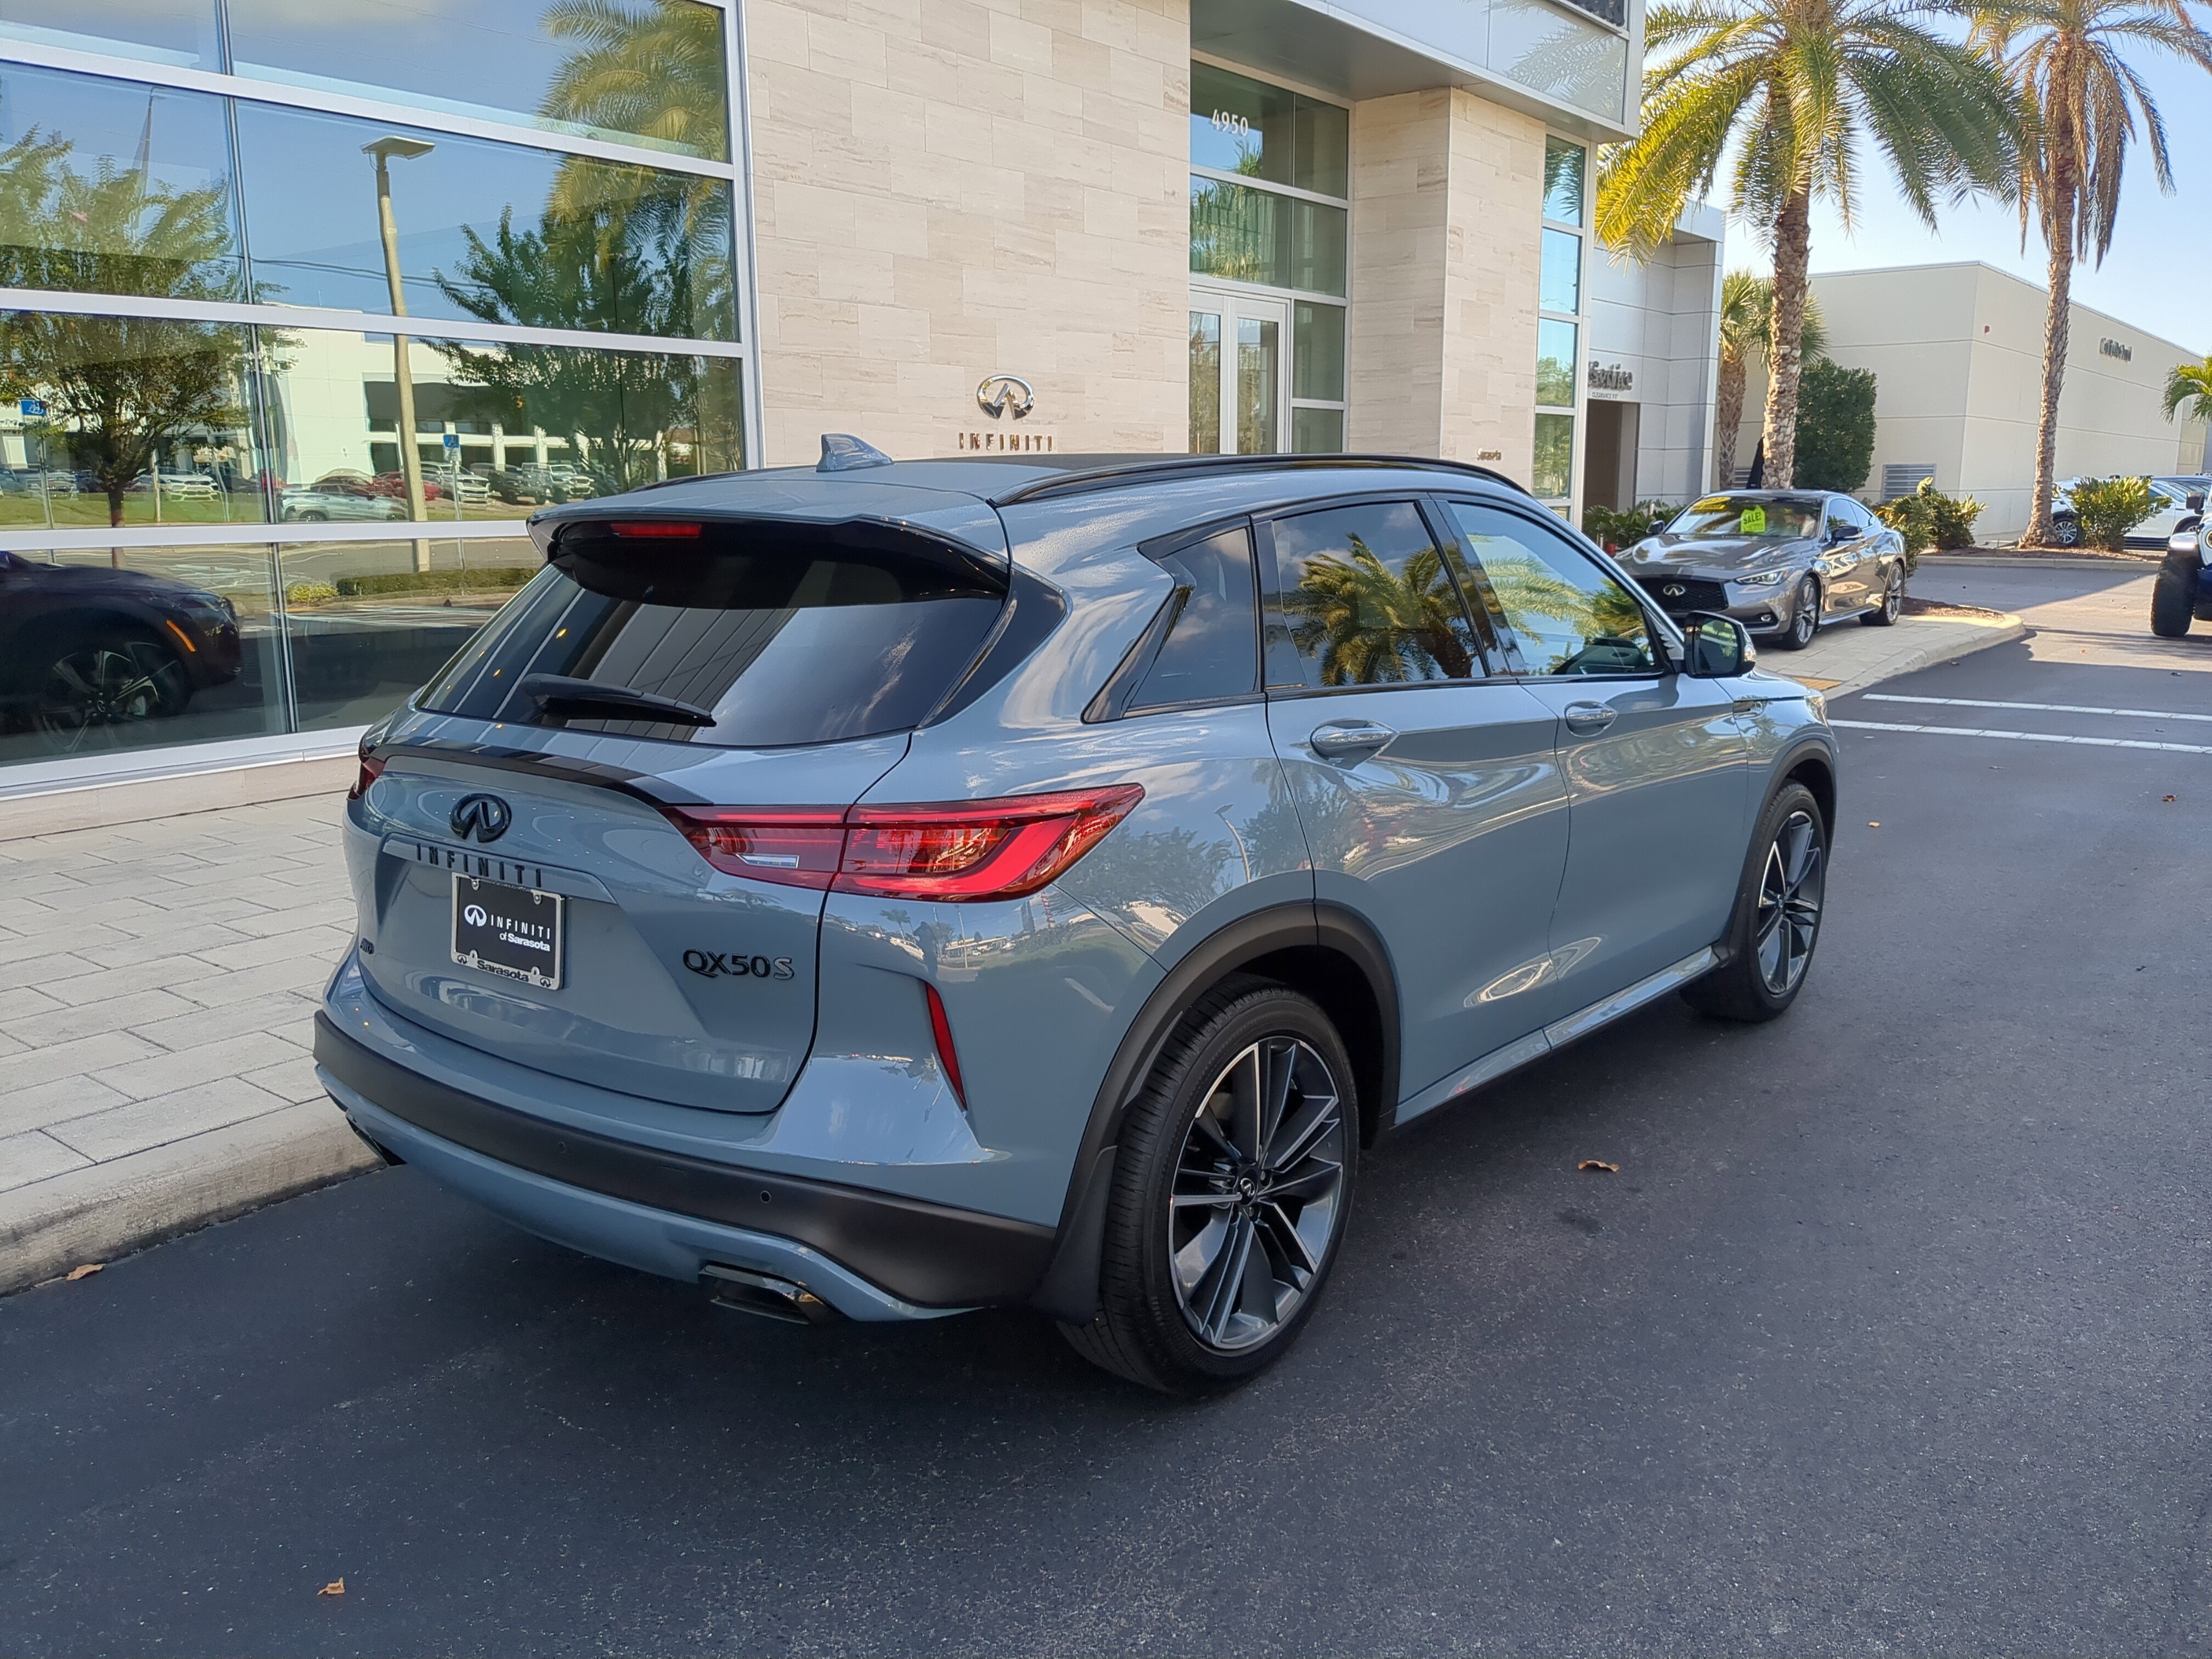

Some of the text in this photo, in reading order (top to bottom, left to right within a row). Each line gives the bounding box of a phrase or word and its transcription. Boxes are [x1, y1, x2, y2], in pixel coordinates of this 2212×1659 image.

[1211, 109, 1249, 137] 4950
[959, 433, 1053, 452] INFINITI
[416, 843, 542, 888] INFINITI
[491, 914, 550, 940] INFINITI
[499, 932, 550, 951] of Sarasota
[477, 960, 529, 982] Sarasota
